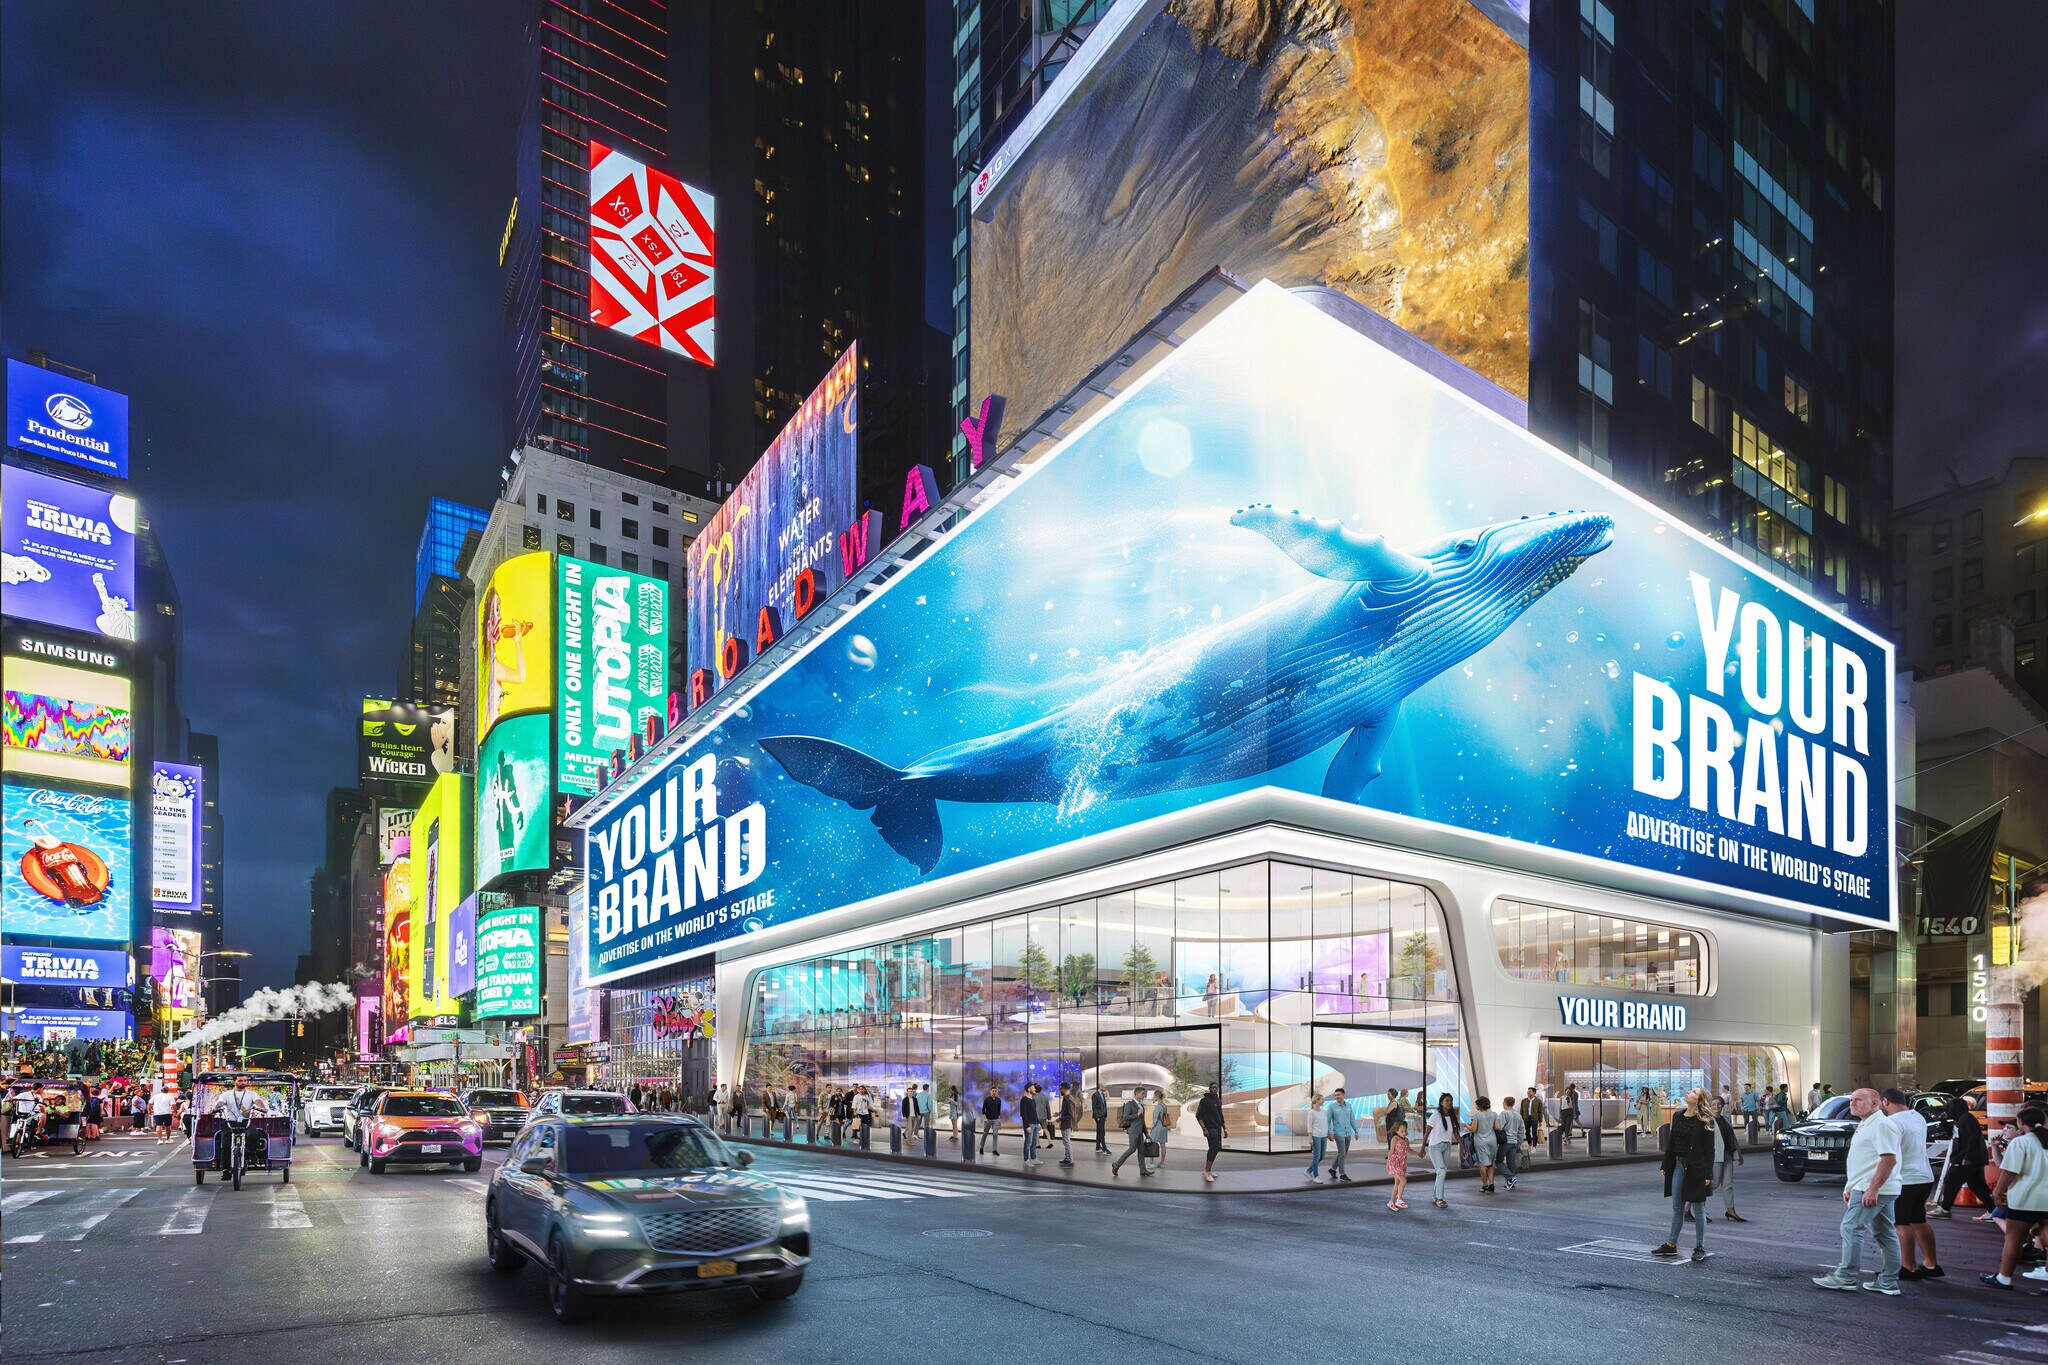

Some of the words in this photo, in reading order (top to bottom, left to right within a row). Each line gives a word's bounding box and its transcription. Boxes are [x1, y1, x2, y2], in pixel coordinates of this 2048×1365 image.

[641, 233, 663, 259] TSX
[27, 419, 110, 453] Prudential
[27, 503, 112, 538] TRIVIA
[27, 516, 112, 546] MOMENTS
[779, 497, 820, 552] WATER
[32, 541, 50, 550] PLAY
[50, 545, 59, 553] TO
[72, 550, 78, 558] A
[565, 562, 582, 586] IN
[768, 531, 833, 607] ELEPHANTS
[565, 587, 582, 649] NIGHT
[21, 639, 116, 667] SAMSUNG
[592, 576, 633, 751] UTOPIA
[1688, 569, 1870, 757] YOUR
[565, 651, 582, 693] ONE
[565, 693, 582, 747] ONLY
[371, 741, 399, 751] Brains.
[400, 744, 426, 753] Heart.
[380, 749, 416, 759] Courage.
[564, 751, 610, 767] METLIFE
[1633, 670, 1869, 858] BRAND
[27, 788, 106, 814] Coca-Cola
[153, 810, 188, 819] LEADERS
[597, 752, 718, 884] YOUR
[1626, 811, 1715, 858] ADVERTISE
[1718, 837, 1739, 865] ON
[1742, 842, 1768, 873] THE
[1770, 855, 1831, 890] WORLD'S
[1833, 870, 1871, 900] STAGE
[598, 803, 767, 945] BRAND
[491, 914, 517, 927] NIGHT
[519, 913, 533, 924] IN
[599, 941, 640, 966] ADVERTISE
[641, 935, 654, 951] ON
[655, 928, 673, 946] THE
[675, 906, 728, 938] WORLD'S
[731, 888, 776, 920] STAGE
[1922, 916, 1978, 936] 1540
[21, 956, 100, 971] TRIVIA
[21, 967, 100, 980] MOMENTS
[489, 972, 534, 987] STADIUM
[504, 985, 513, 997] 9
[1972, 954, 1989, 1022] 1540
[1558, 997, 1619, 1028] YOUR
[1620, 1001, 1686, 1032] BRAND
